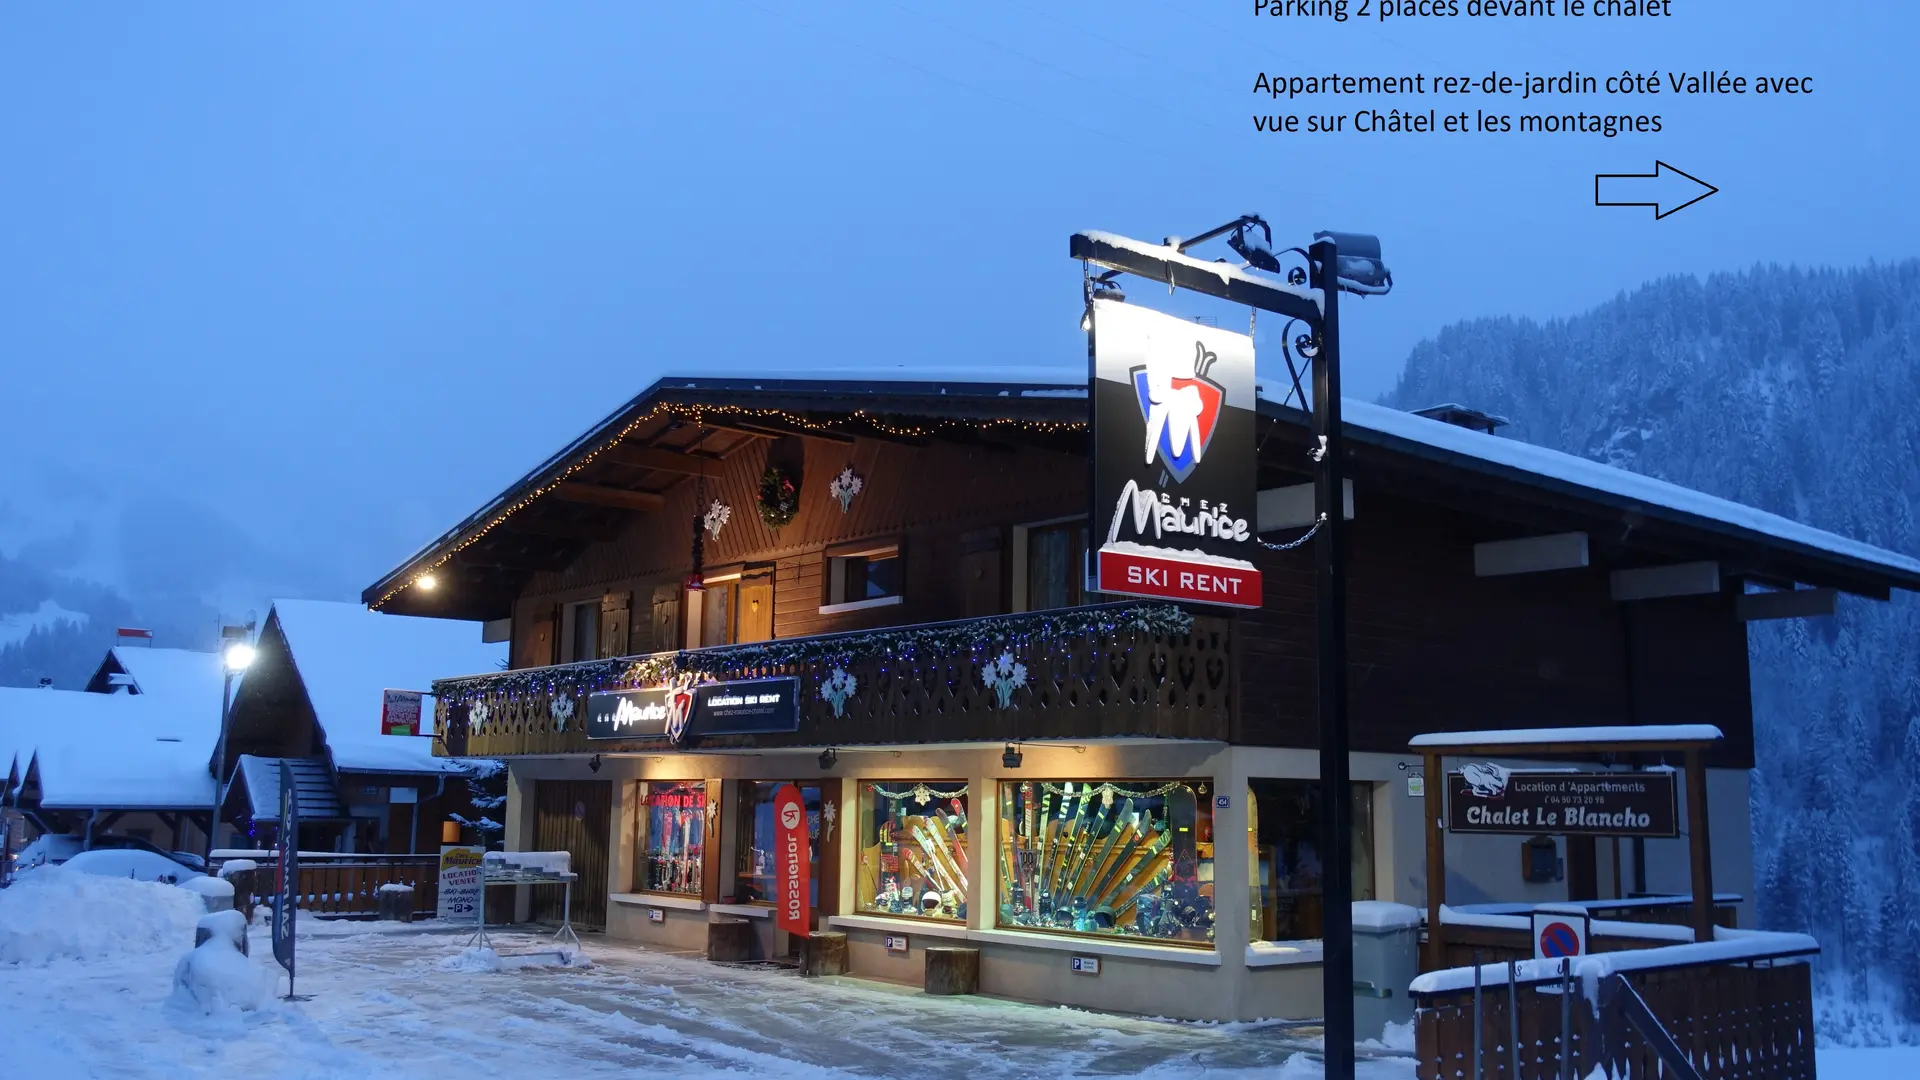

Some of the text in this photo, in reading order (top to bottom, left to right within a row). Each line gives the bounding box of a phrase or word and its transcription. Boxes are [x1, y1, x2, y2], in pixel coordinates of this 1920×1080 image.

[1108, 479, 1250, 543] Maurice
[1127, 565, 1242, 595] SKI RENT
[707, 693, 781, 707] LOCATION SKI RENT
[614, 697, 666, 731] Maurice
[1515, 781, 1557, 792] Location
[640, 794, 681, 807] LOCATION
[683, 794, 694, 808] DE
[1466, 805, 1651, 828] Chalet Le Blancho
[448, 877, 477, 886] VENTE
